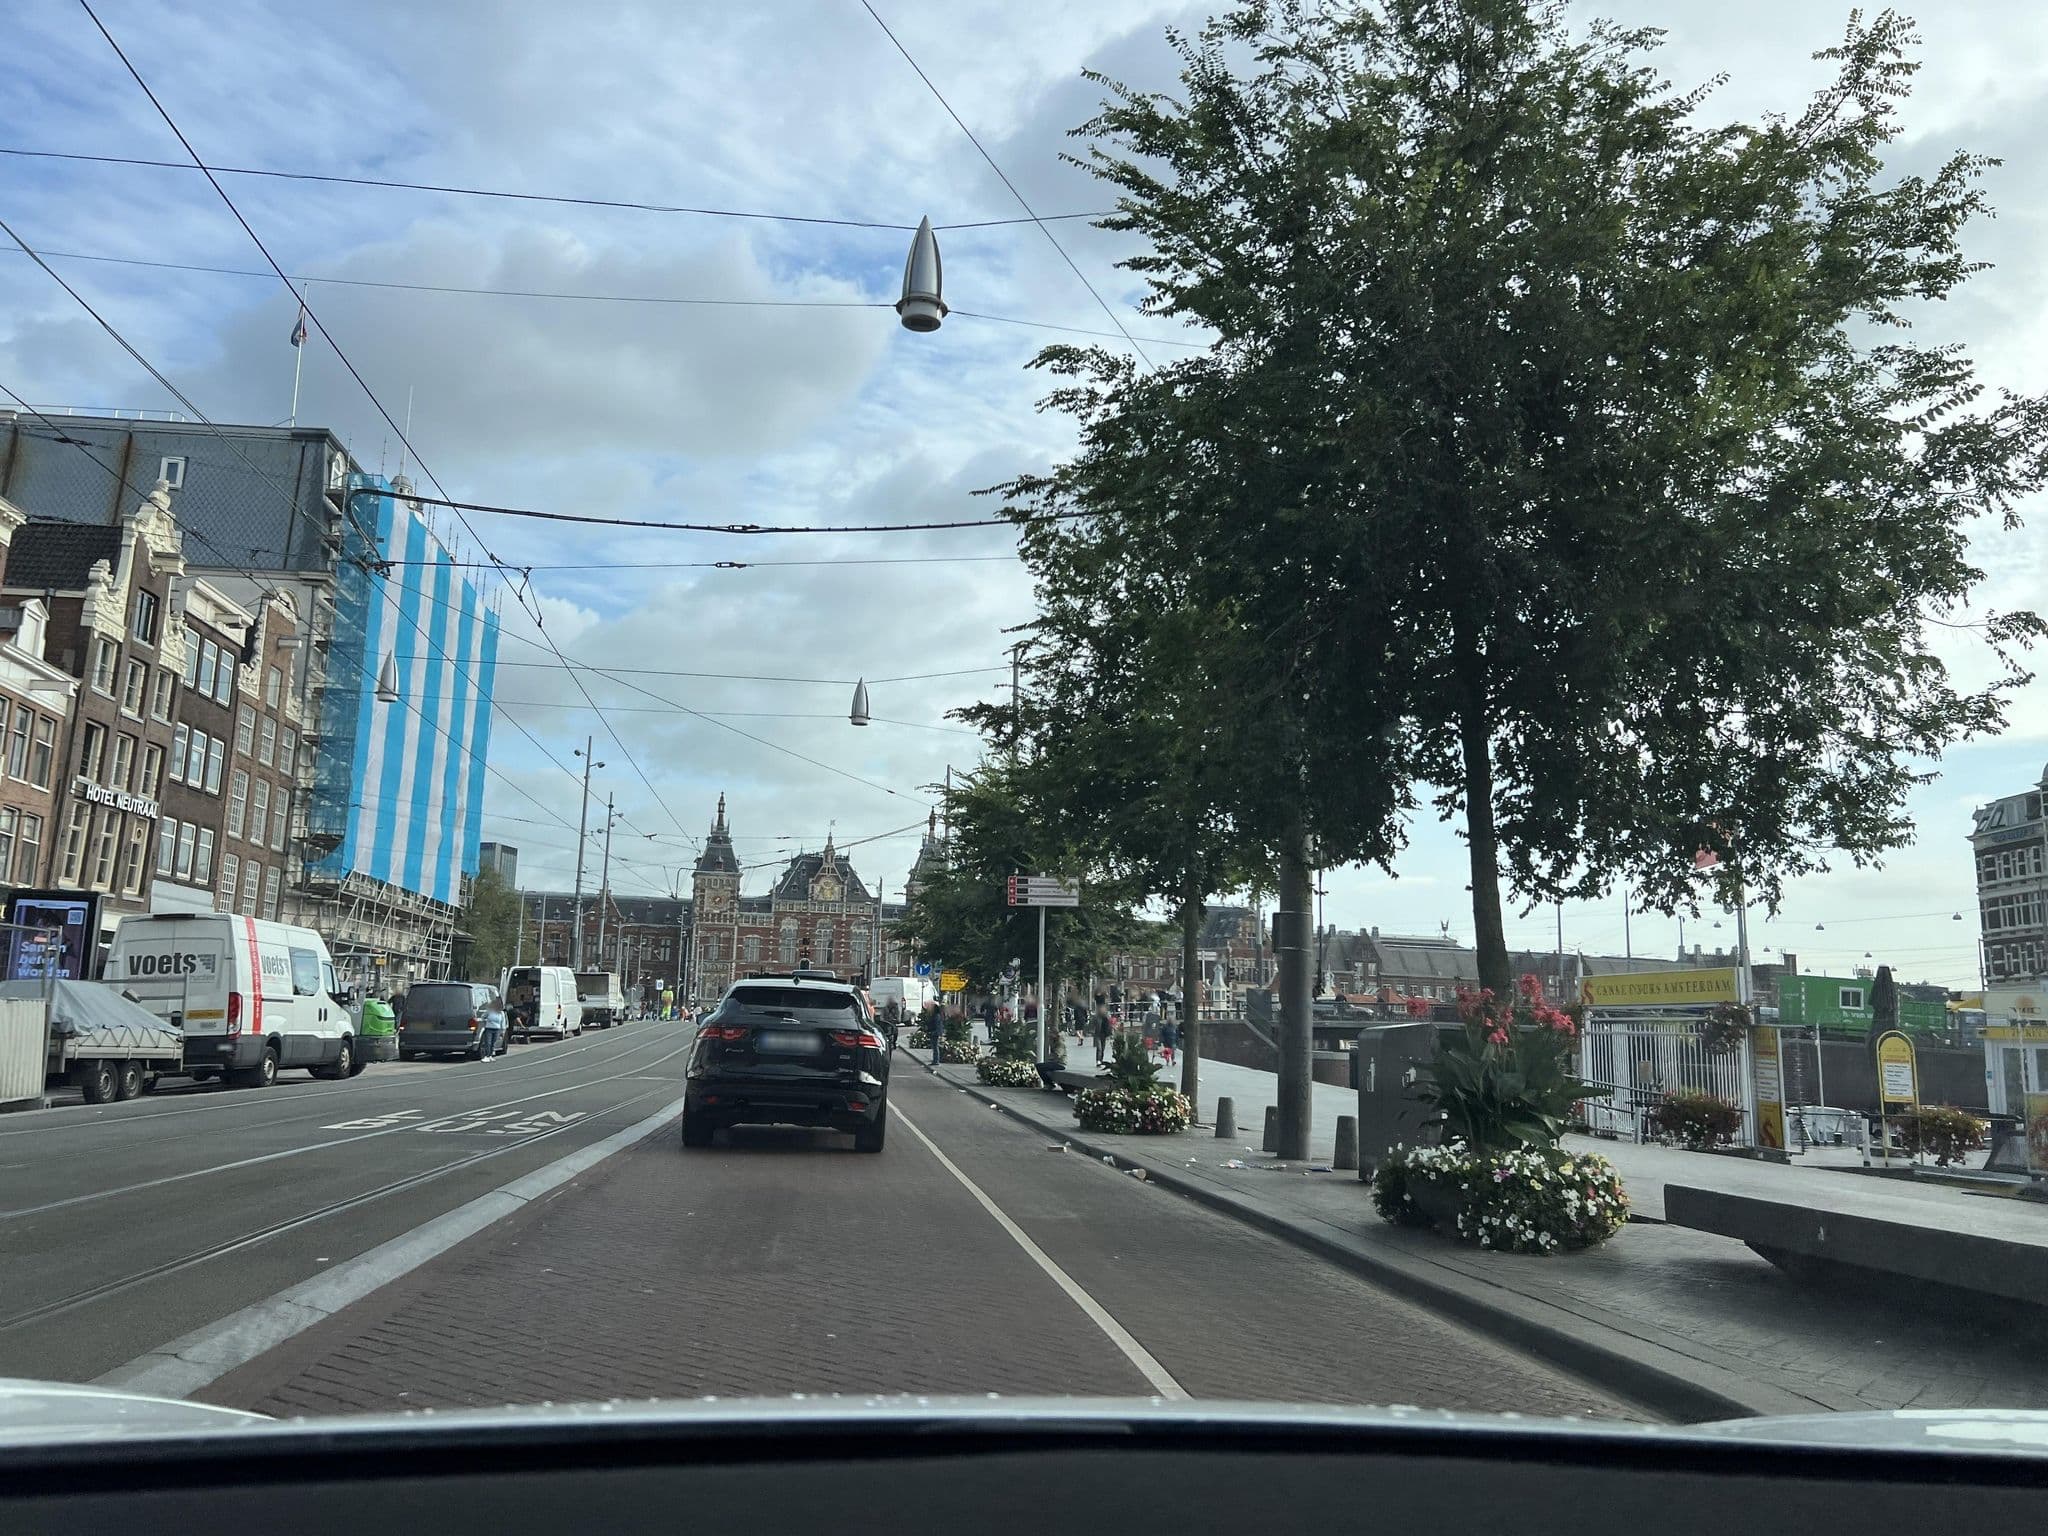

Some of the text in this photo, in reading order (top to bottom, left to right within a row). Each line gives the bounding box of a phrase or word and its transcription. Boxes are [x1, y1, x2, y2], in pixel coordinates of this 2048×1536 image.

[86, 783, 159, 819] HOTEL NEUTRAAL
[20, 941, 67, 953] Samn
[18, 953, 56, 965] betr
[129, 952, 197, 976] voets
[261, 955, 285, 976] voets
[1663, 980, 1731, 994] AMSTERDAM
[376, 1109, 588, 1122] LIJN
[318, 1117, 558, 1134] BUS
